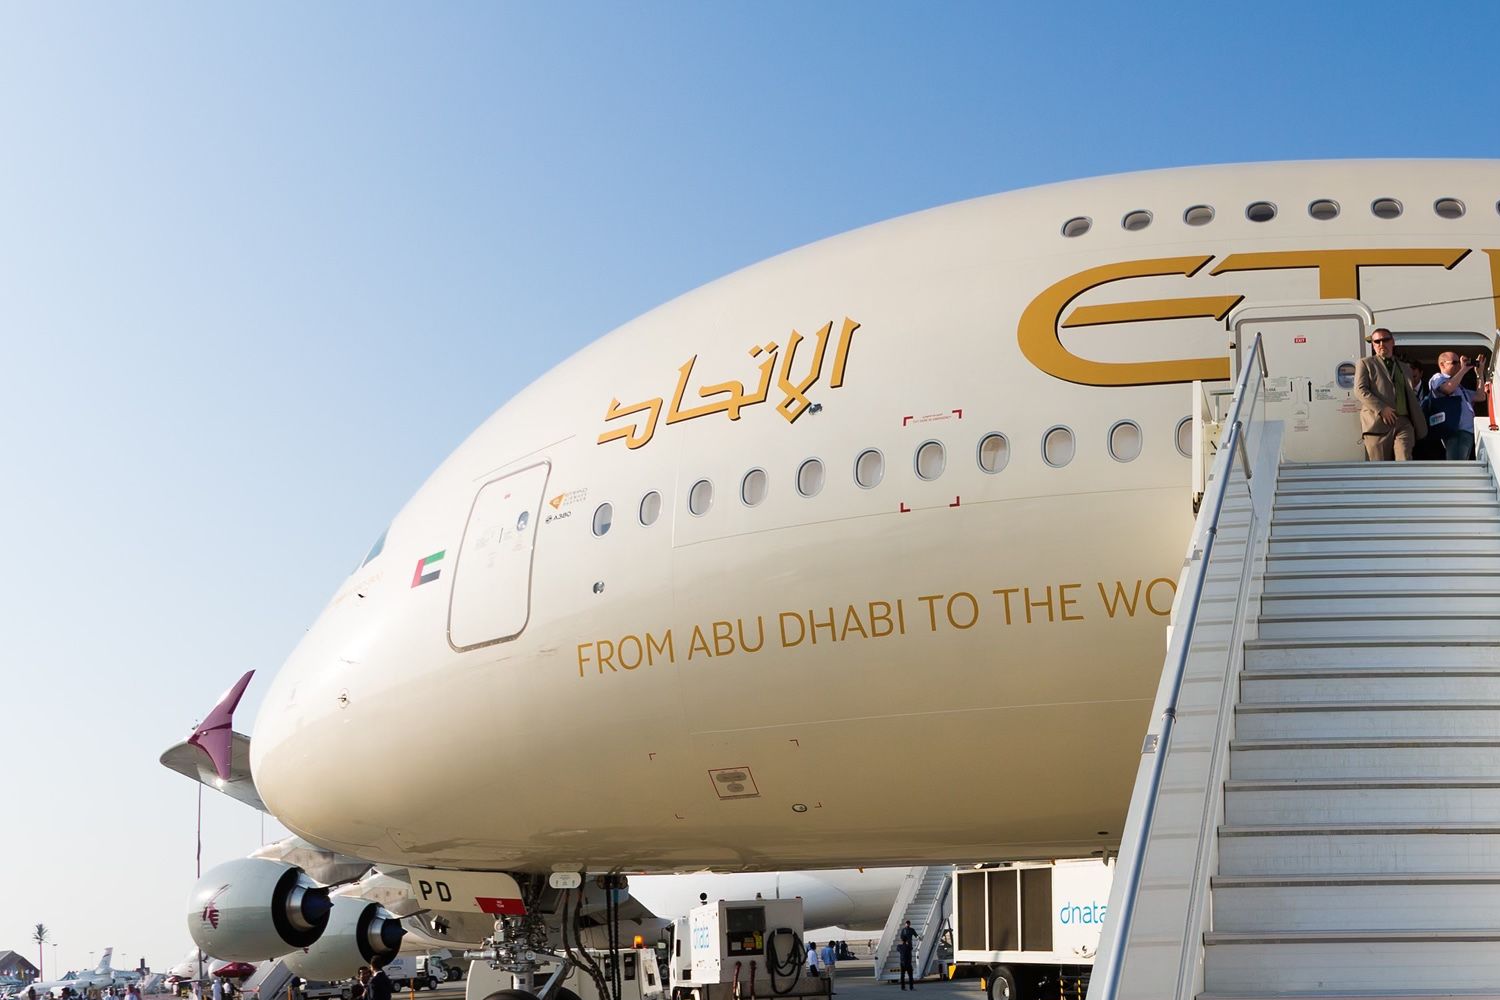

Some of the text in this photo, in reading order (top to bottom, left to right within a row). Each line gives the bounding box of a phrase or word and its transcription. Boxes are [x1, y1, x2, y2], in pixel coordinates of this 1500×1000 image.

[577, 628, 675, 677] FROM
[688, 616, 764, 661] ABU
[779, 599, 905, 649] DHABI
[918, 591, 979, 631] TO
[992, 583, 1084, 627] THE
[419, 880, 452, 902] PD
[1060, 900, 1107, 924] dnata
